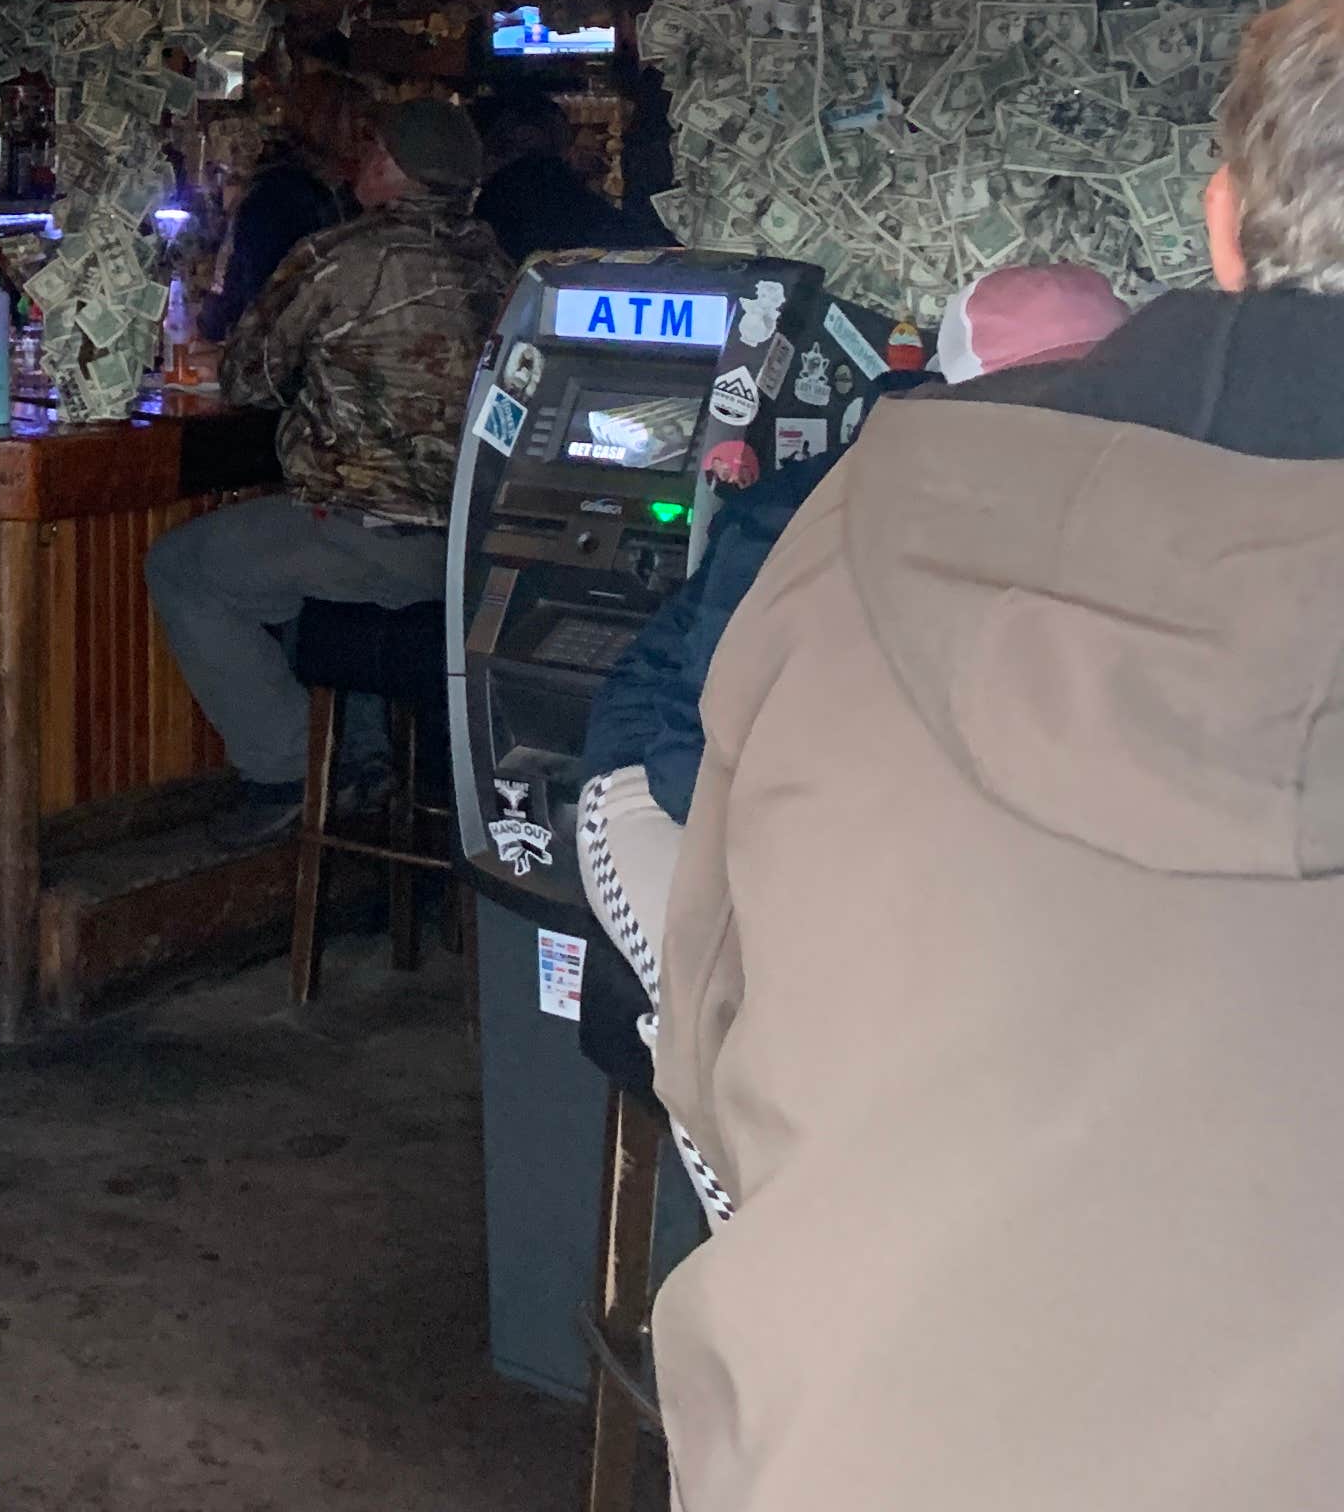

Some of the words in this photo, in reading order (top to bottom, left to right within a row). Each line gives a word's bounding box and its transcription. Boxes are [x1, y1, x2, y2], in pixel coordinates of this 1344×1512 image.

[587, 295, 693, 338] ATM
[568, 441, 593, 458] GET
[593, 443, 626, 461] CASH
[523, 824, 550, 842] OUT
